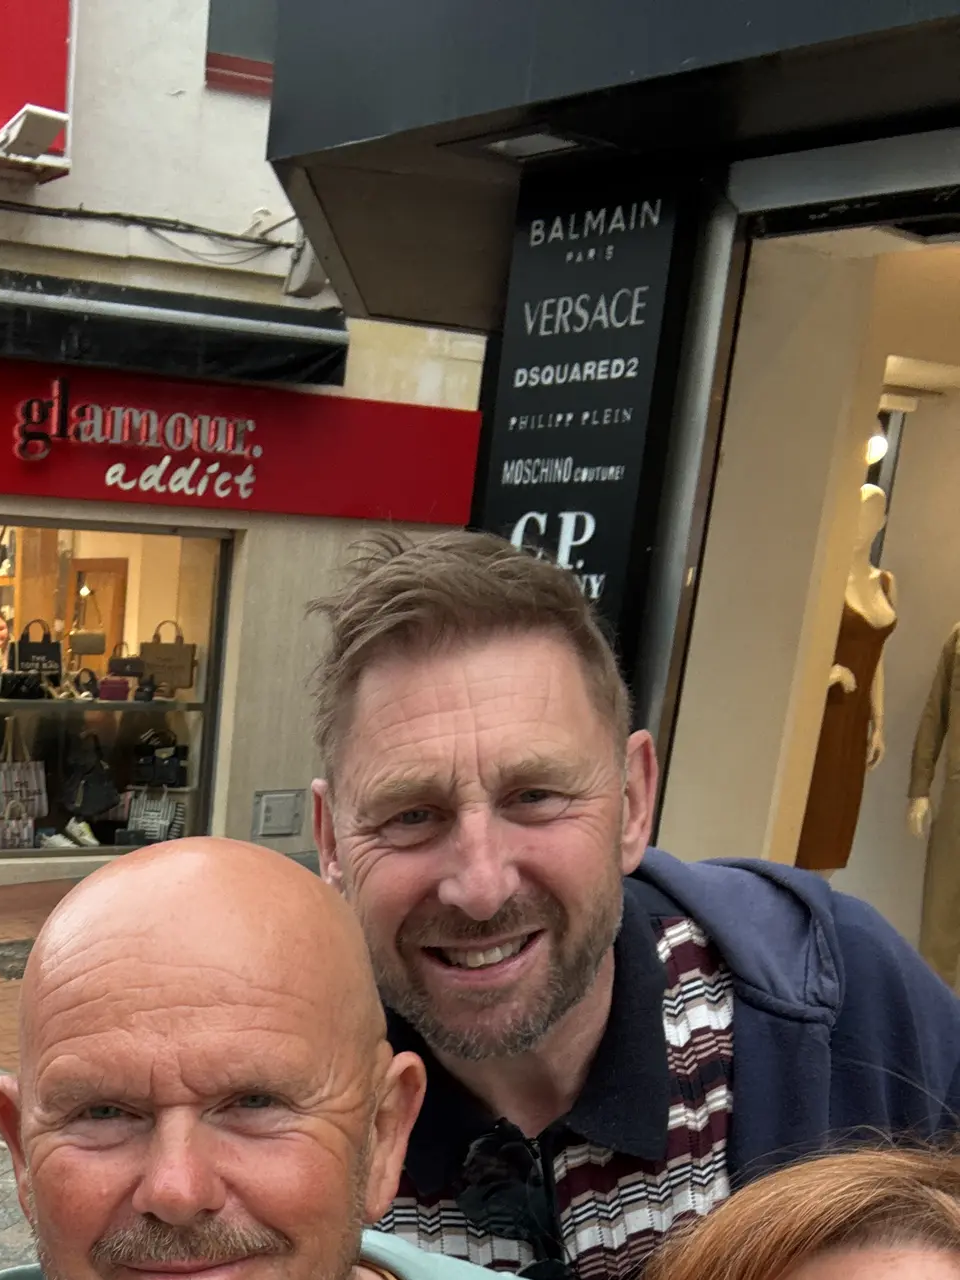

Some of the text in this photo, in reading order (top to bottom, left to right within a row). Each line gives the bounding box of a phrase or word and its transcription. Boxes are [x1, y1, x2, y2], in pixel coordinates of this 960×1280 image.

[529, 199, 662, 248] BALMAIN
[524, 285, 650, 336] VERSACE
[513, 357, 640, 388] DSQUARED2
[13, 378, 263, 460] glamour.
[507, 408, 634, 432] PHILIPP PLEIN
[105, 455, 257, 499] addict
[500, 456, 574, 487] MOSCHINO
